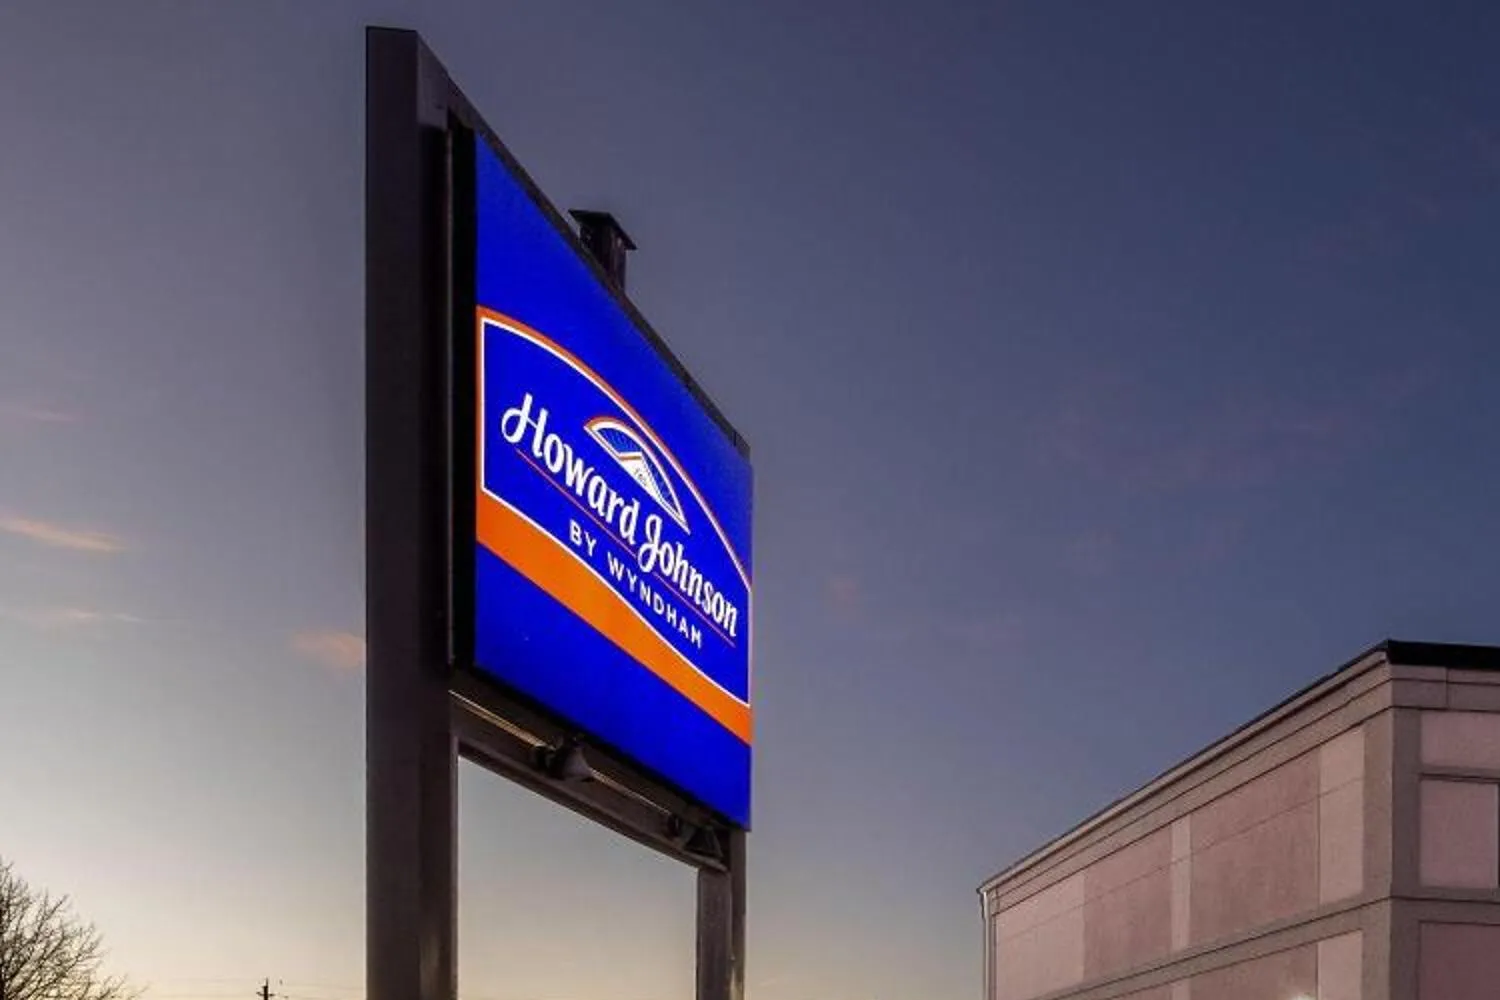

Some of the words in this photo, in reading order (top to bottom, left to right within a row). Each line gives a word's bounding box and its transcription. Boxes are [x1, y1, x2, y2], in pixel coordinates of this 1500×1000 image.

[501, 392, 640, 546] Howard
[638, 514, 737, 637] Johnson
[569, 520, 597, 556] BY
[607, 551, 702, 649] WYNDHAM
